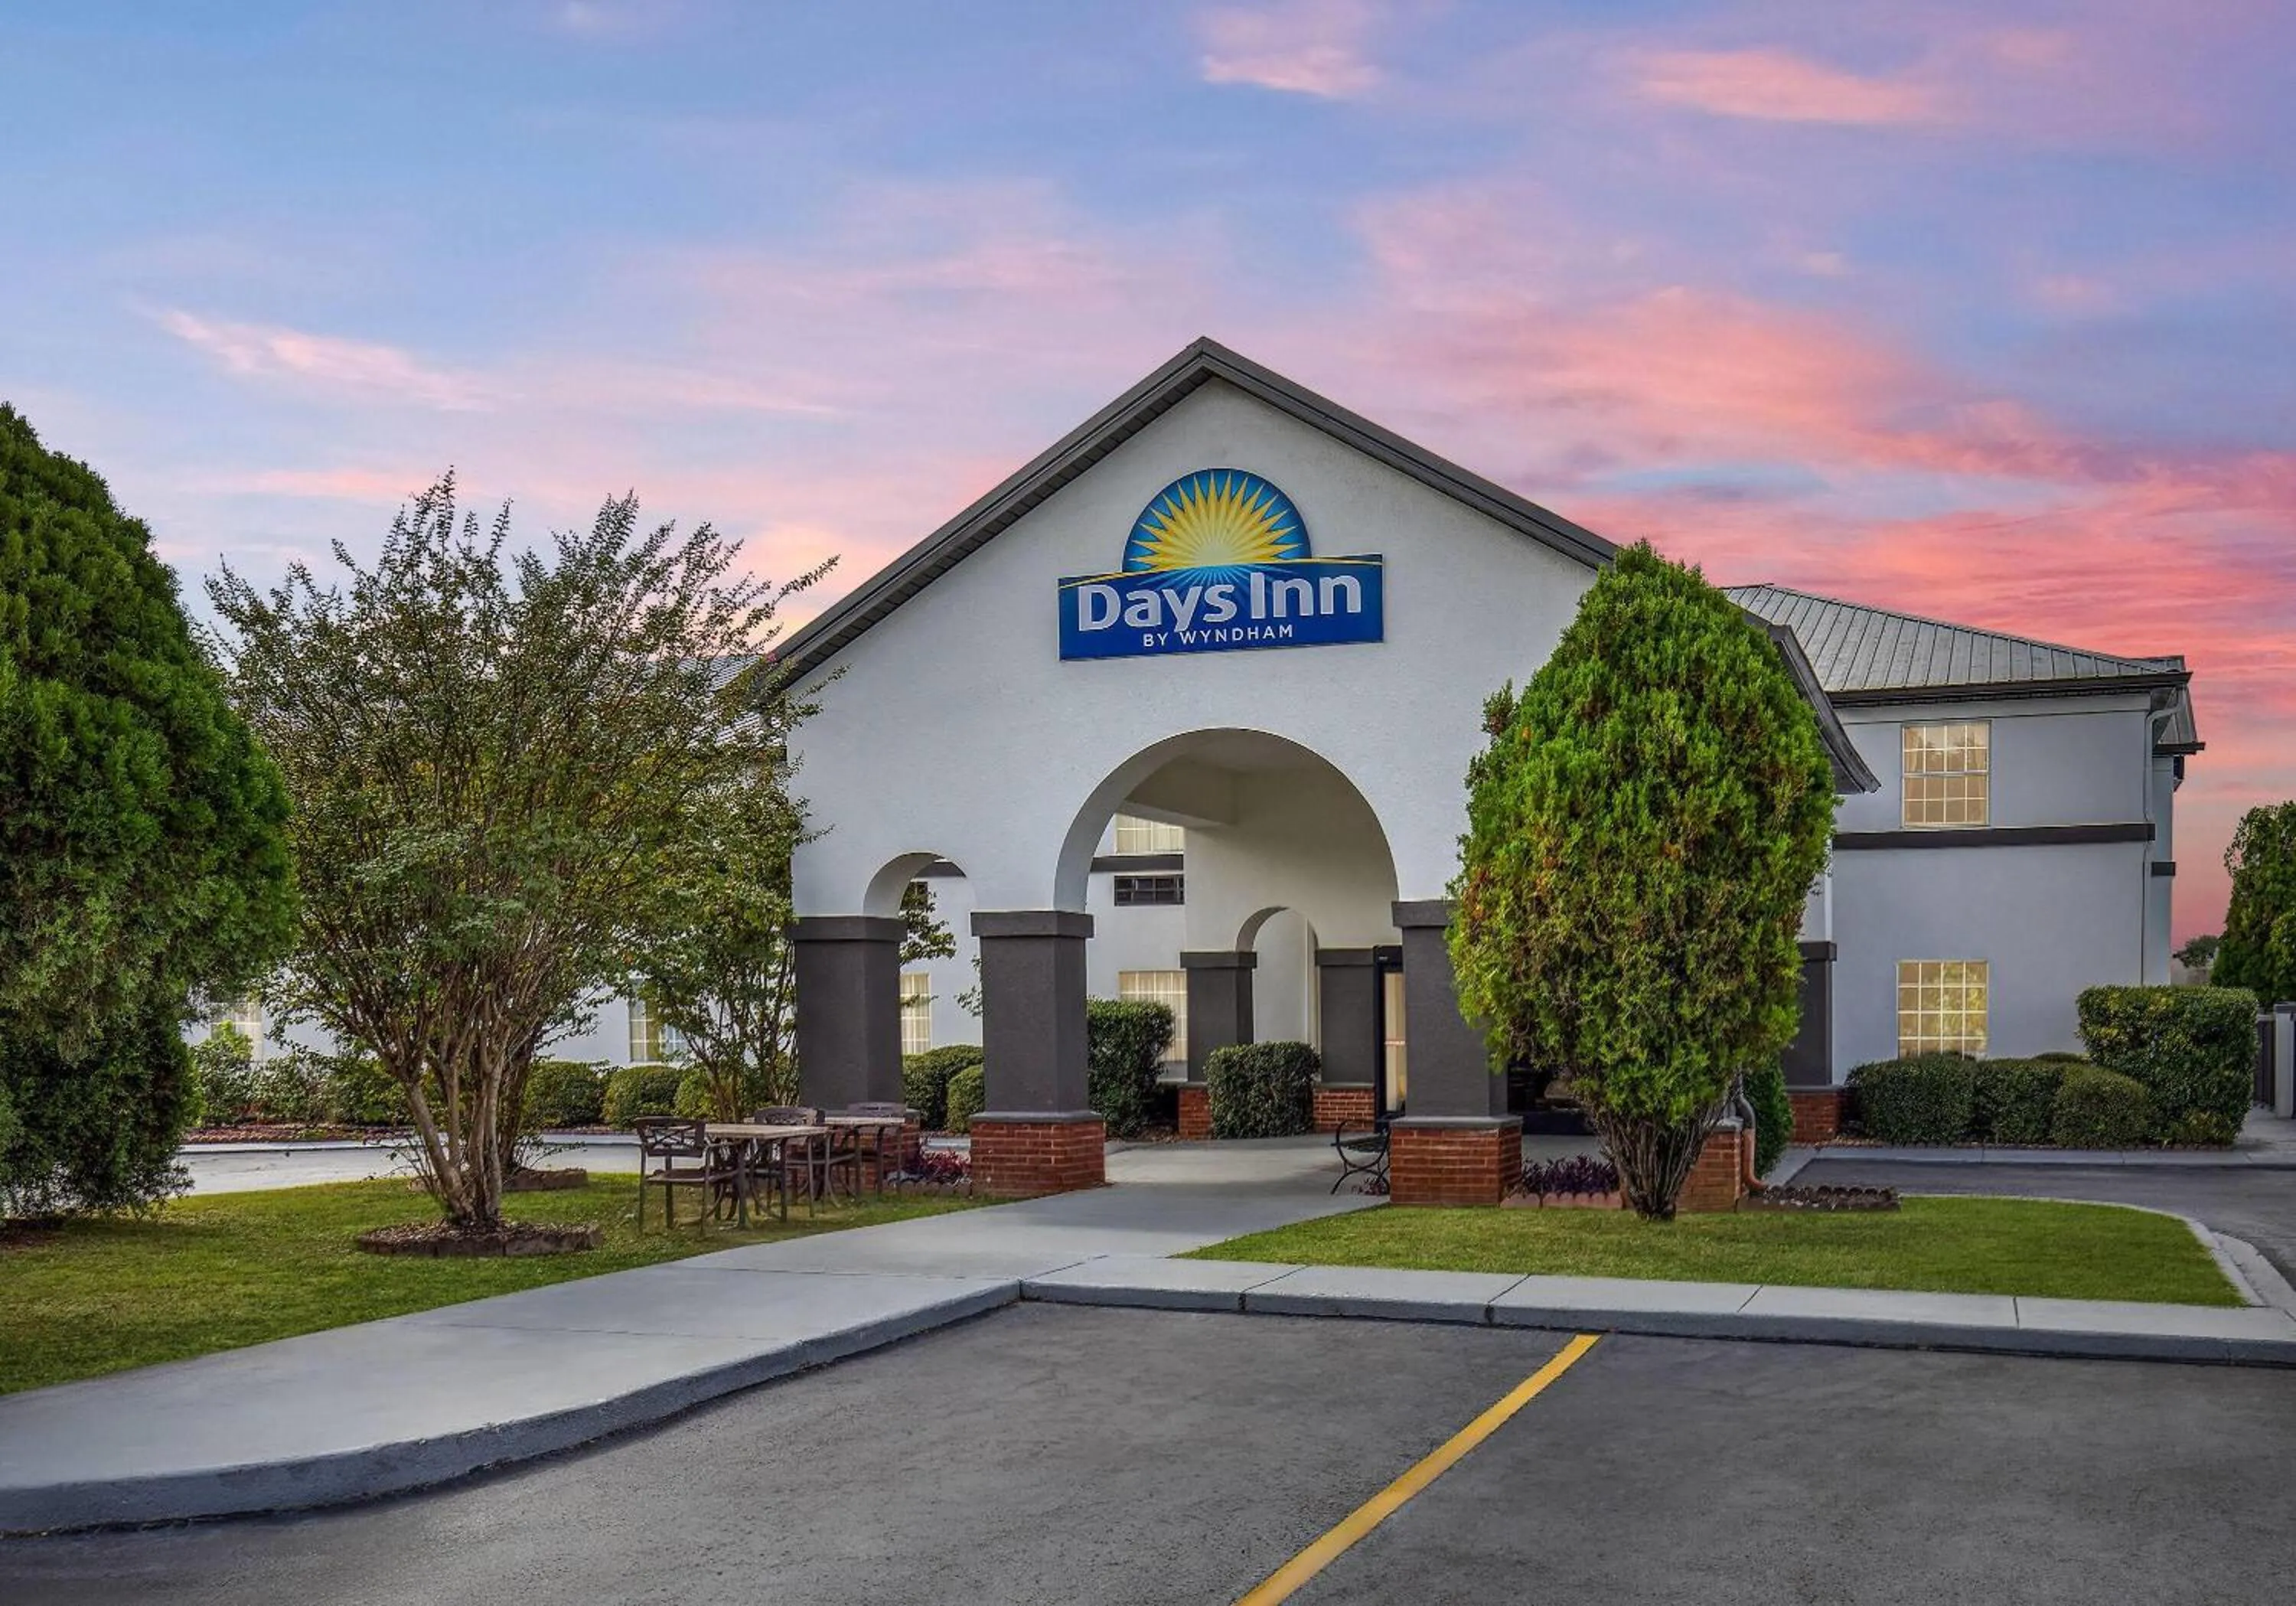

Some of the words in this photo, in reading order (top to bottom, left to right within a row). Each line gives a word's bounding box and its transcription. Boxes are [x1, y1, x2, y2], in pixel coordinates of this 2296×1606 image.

[1078, 583, 1238, 632] Days
[1250, 572, 1362, 620] Inn
[1143, 633, 1167, 648] BY
[1179, 624, 1293, 645] WYNDHAM
